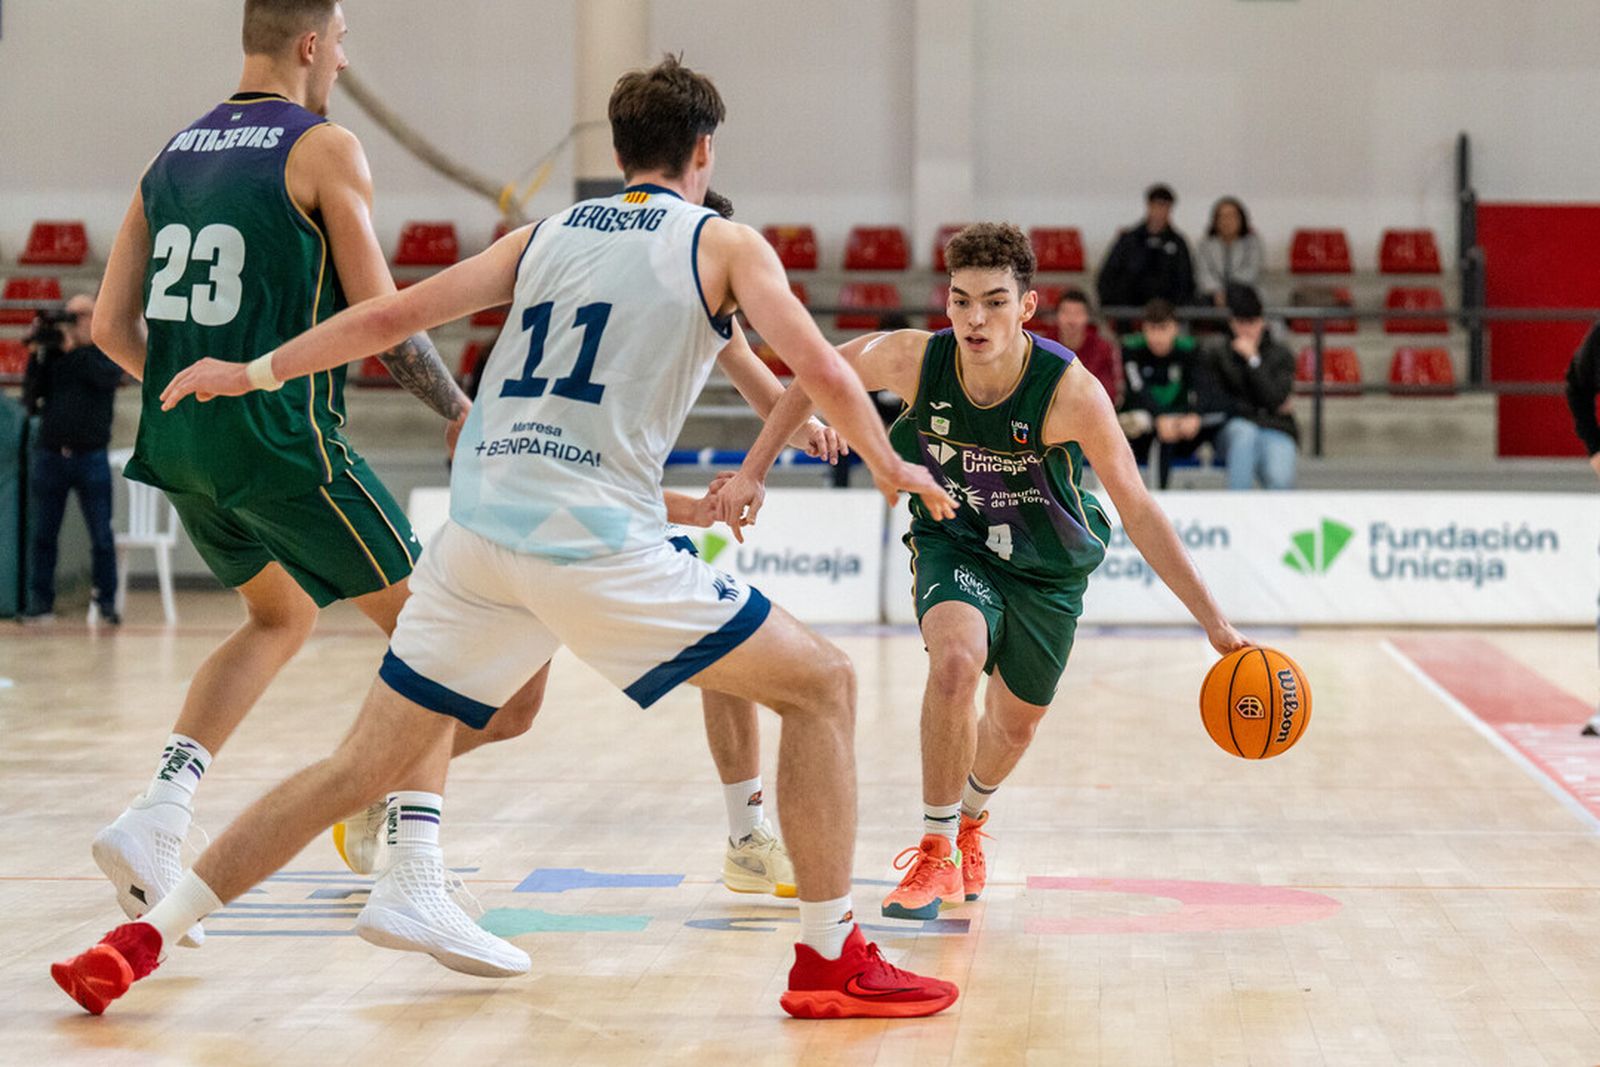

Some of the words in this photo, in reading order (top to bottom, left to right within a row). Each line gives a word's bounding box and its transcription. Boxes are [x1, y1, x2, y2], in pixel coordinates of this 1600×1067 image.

[145, 223, 246, 326] 23
[499, 301, 613, 405] 11
[963, 461, 1027, 476] Unicaja
[991, 487, 1040, 500] Alhaurín
[991, 498, 1006, 508] de
[1008, 498, 1019, 506] la
[1369, 521, 1559, 551] Fundación
[736, 546, 862, 583] Unicaja
[1369, 551, 1506, 587] Unicaja
[1275, 669, 1299, 743] Wilson
